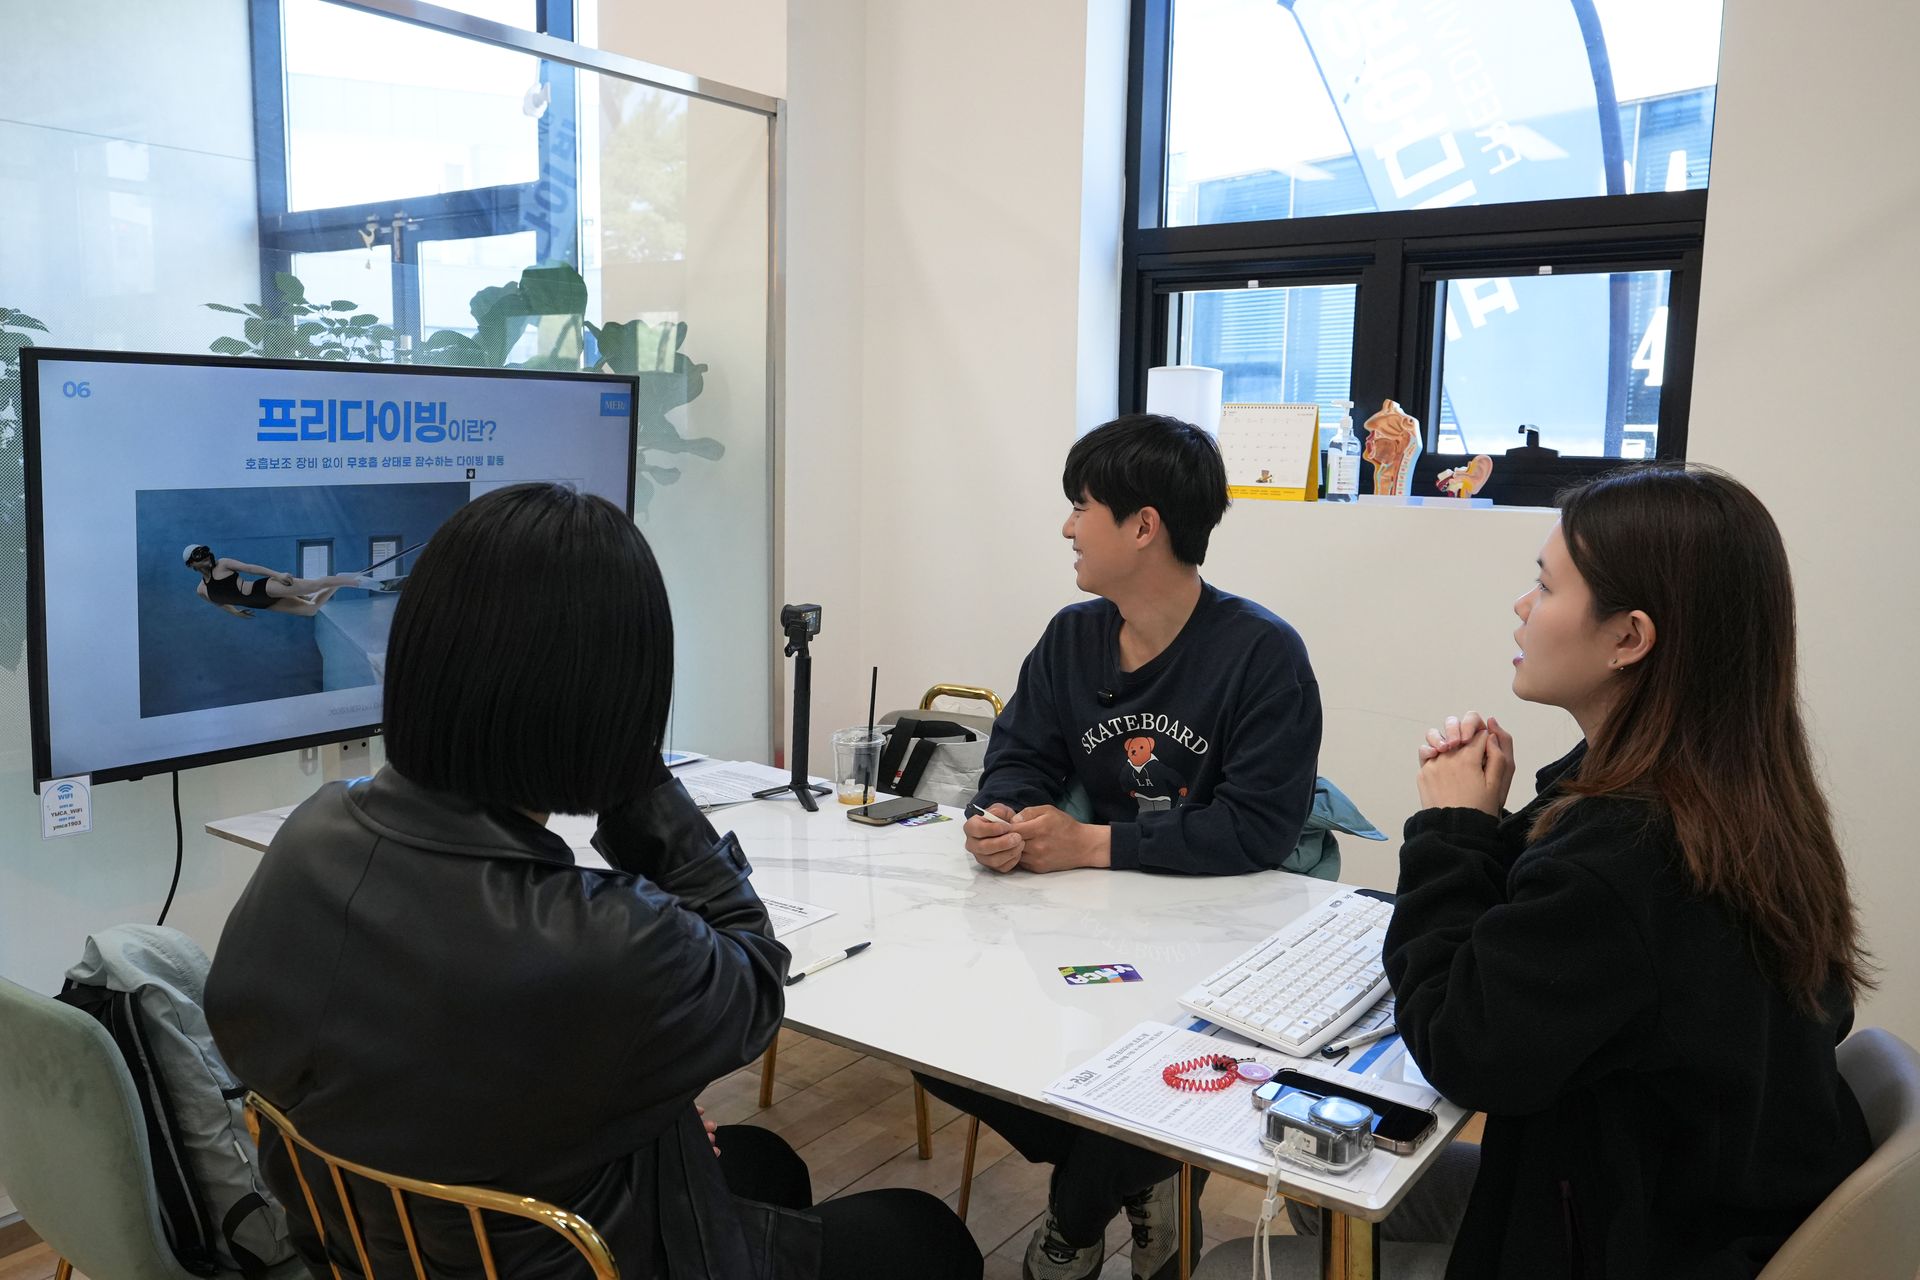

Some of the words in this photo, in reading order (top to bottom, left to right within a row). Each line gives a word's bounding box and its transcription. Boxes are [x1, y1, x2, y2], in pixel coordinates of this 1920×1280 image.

[63, 381, 91, 398] 06
[257, 399, 497, 443] 프리다이빙이란?
[245, 457, 292, 470] 호흡보조
[296, 457, 318, 469] 장비
[322, 457, 343, 469] 없이
[347, 457, 378, 468] 무호흡
[382, 456, 412, 468] 상태로
[415, 456, 453, 468] 잠수하는
[457, 455, 484, 467] 다이빙
[487, 455, 505, 466] 활동
[1081, 713, 1209, 755] SKATEBOARD
